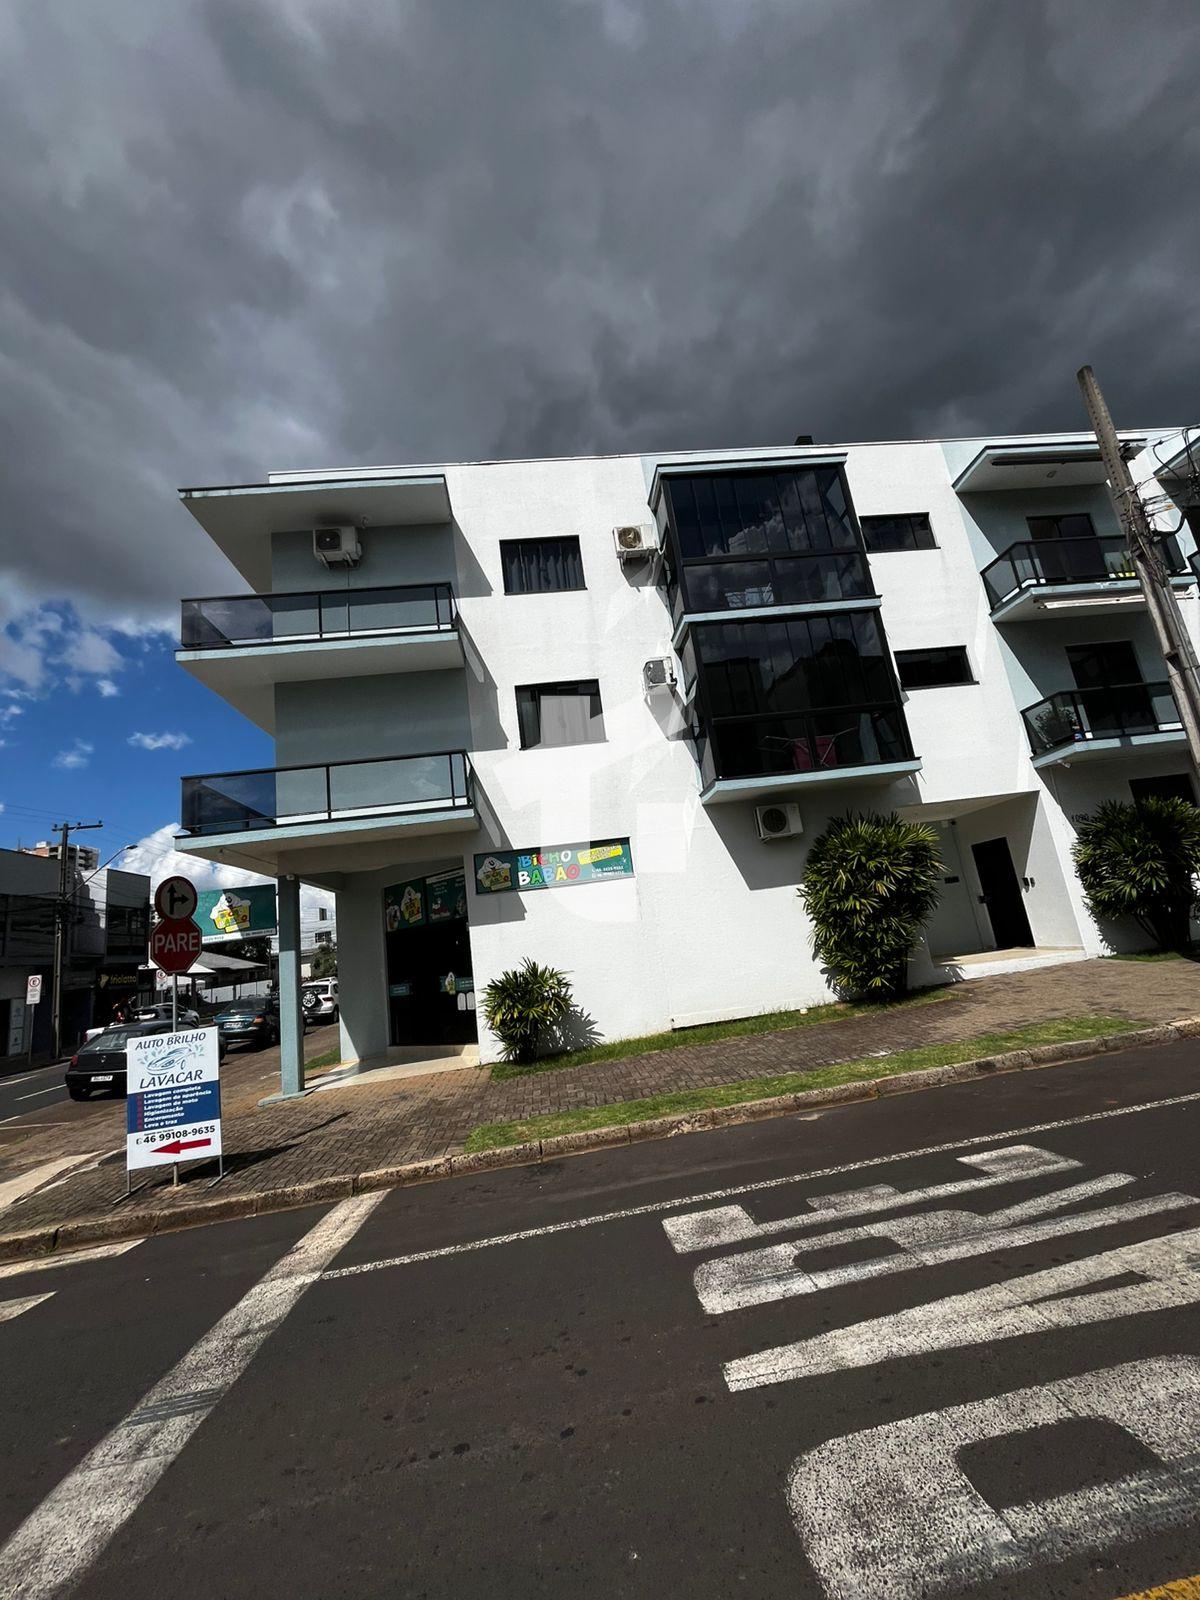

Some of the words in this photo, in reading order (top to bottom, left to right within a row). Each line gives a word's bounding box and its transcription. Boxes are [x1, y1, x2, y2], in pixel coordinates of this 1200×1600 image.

[518, 863, 581, 886] BABÃO
[154, 932, 200, 954] PARE
[135, 1037, 165, 1050] AUTO
[166, 1032, 207, 1046] BRILHO
[139, 1069, 204, 1089] LAVACAR
[144, 1089, 172, 1099] Lavagem
[172, 1085, 202, 1096] completa
[144, 1095, 172, 1105] Lavagem
[144, 1101, 172, 1111] Lavagem
[143, 1134, 157, 1144] 46
[158, 1125, 216, 1142] 99108-9635
